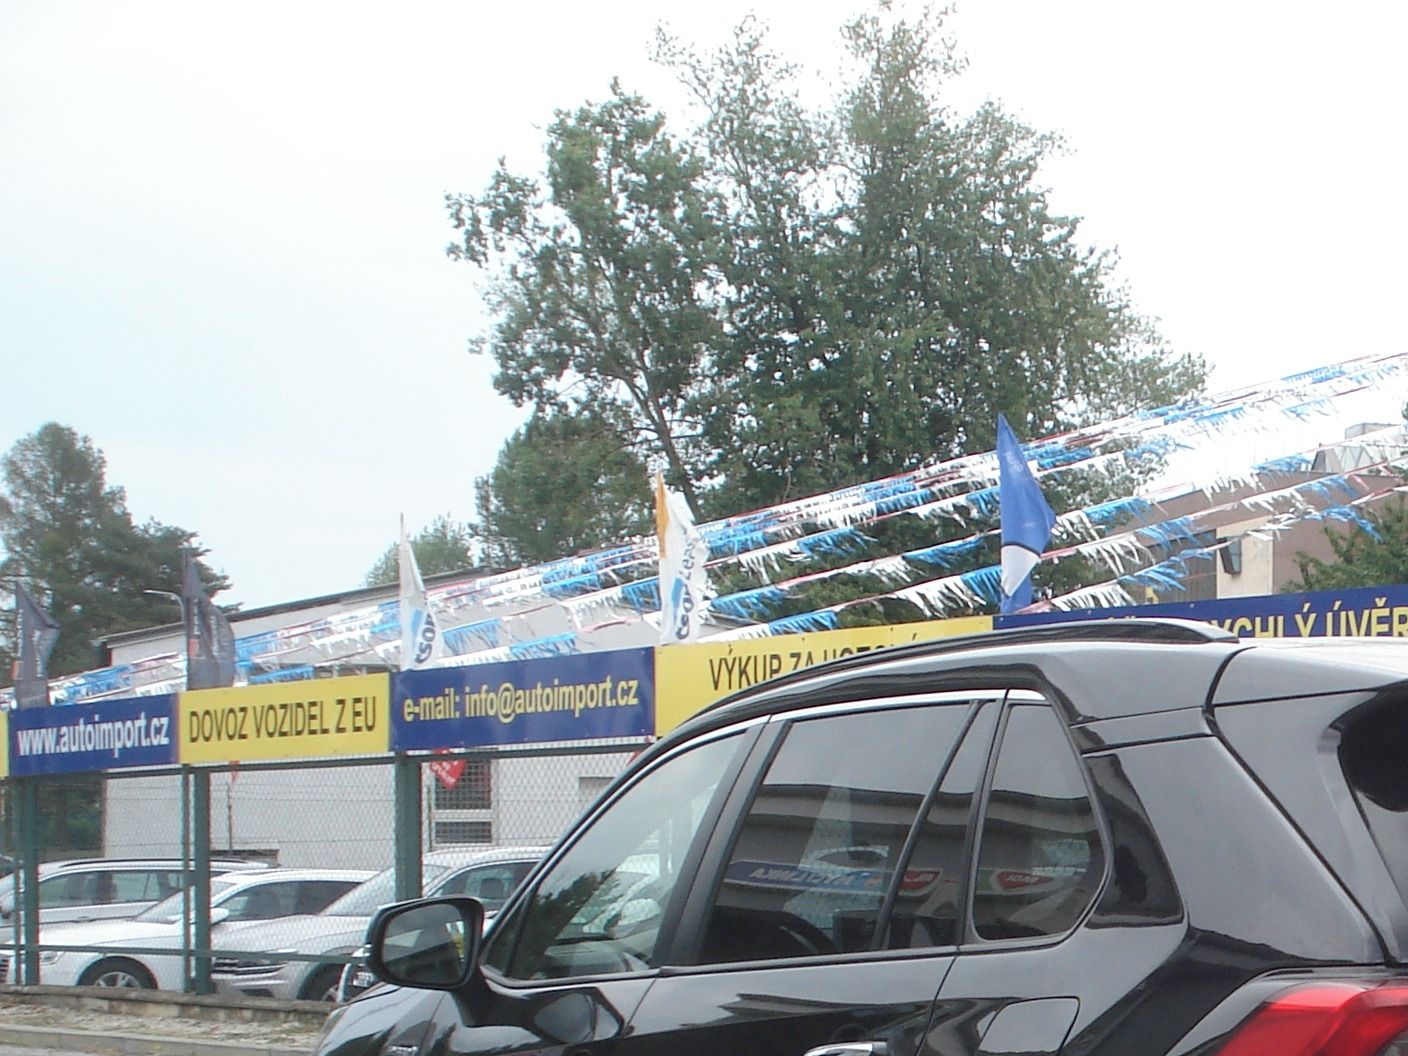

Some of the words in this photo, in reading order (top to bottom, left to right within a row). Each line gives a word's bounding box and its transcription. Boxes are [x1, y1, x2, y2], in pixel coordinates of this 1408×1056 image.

[709, 646, 782, 691] VÝKUP
[189, 706, 248, 743] DOVOZ
[253, 700, 330, 738] VOZIDEL
[335, 698, 347, 734] Z
[352, 696, 376, 733] EU
[403, 687, 460, 722] e-mail:
[465, 675, 639, 724] info@autoimport.cz
[17, 711, 170, 758] www.autoimport.cz
